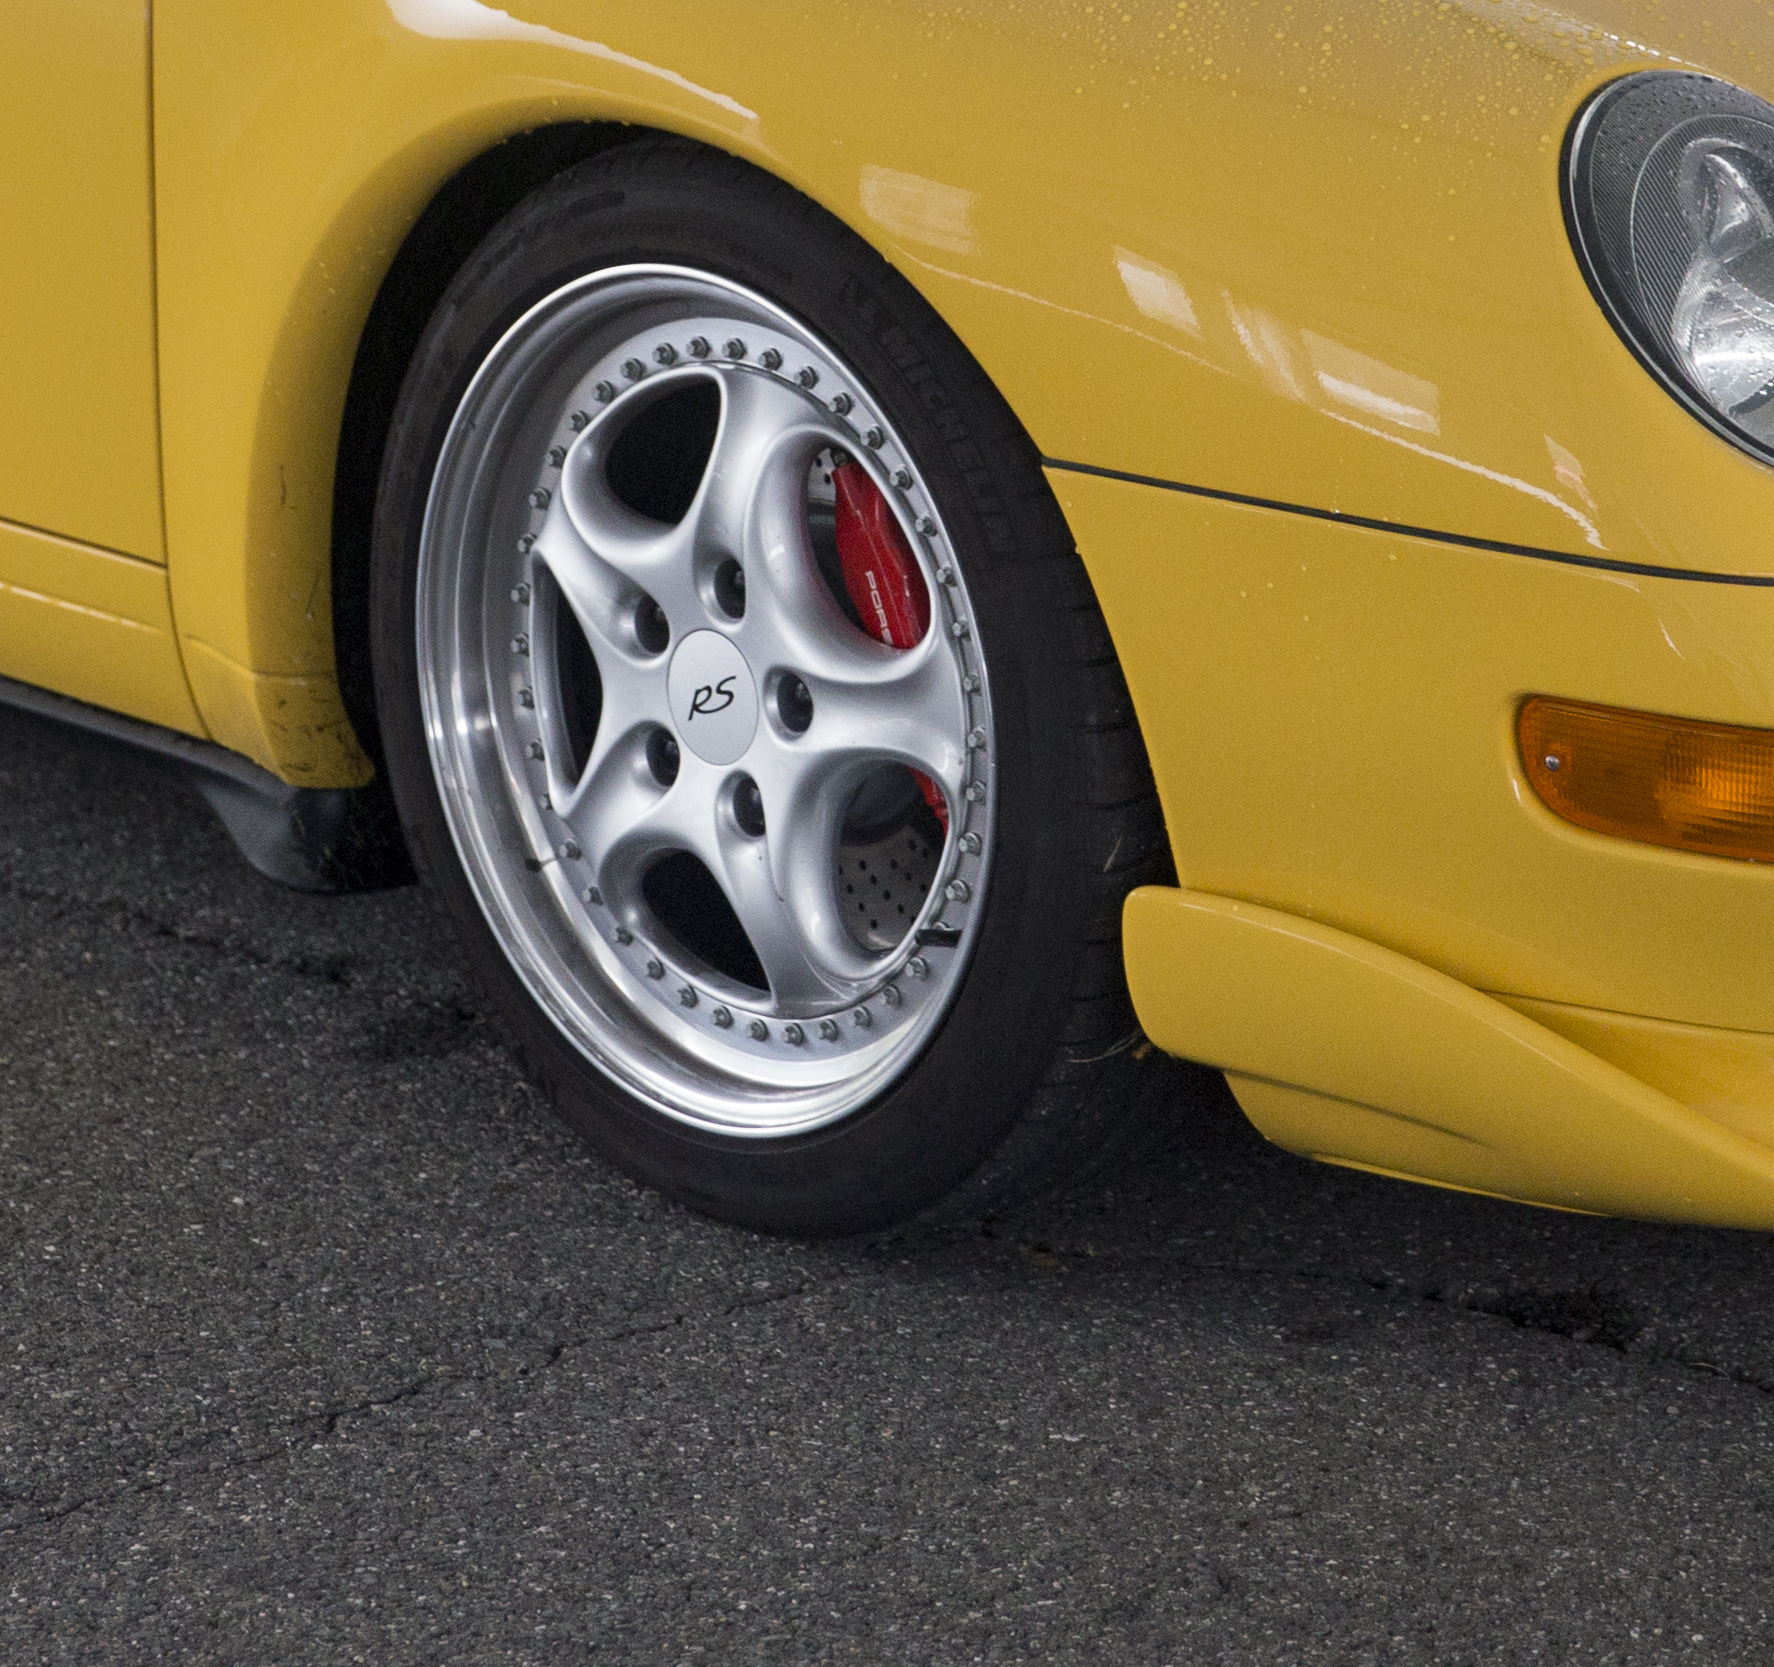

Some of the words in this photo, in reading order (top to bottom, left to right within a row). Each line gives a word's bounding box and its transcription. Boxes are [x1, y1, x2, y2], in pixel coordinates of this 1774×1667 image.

[881, 325, 1017, 553] MICHELIN
[864, 569, 894, 645] PORS
[688, 675, 737, 721] RS
